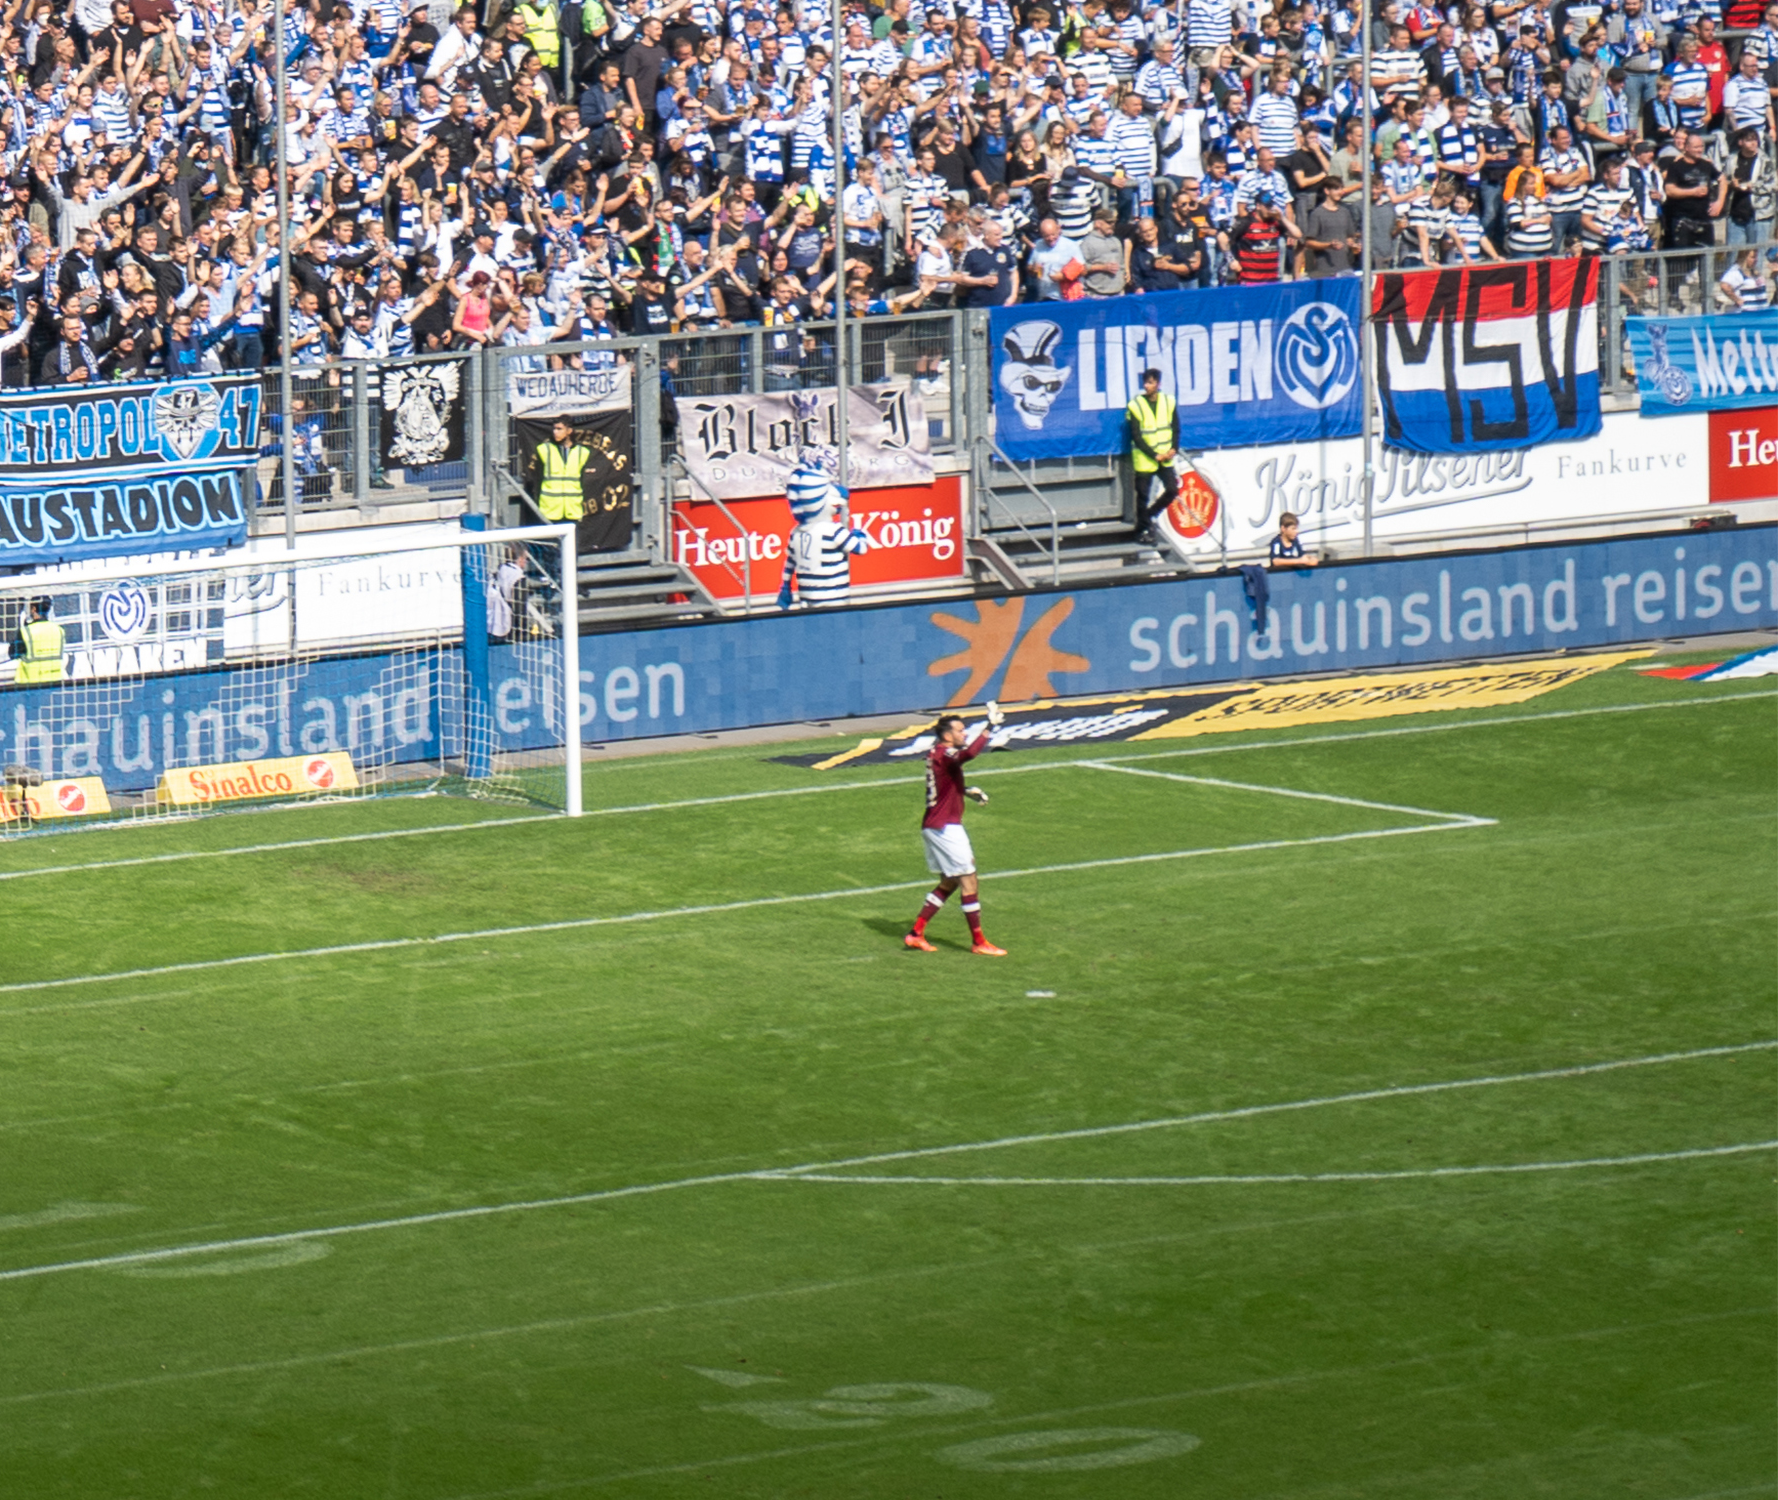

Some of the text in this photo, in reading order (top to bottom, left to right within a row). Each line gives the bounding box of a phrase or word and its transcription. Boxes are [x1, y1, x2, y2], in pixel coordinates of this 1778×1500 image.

[1076, 316, 1276, 413] LIENDEN
[1372, 255, 1596, 445] MSV
[694, 400, 853, 461] Block
[1247, 452, 1376, 528] König
[1556, 448, 1689, 481] Fankurve
[675, 507, 956, 568] Heute König
[317, 565, 462, 598] Fankurve
[66, 637, 209, 680] ANAKEN
[496, 655, 687, 748] eisen
[189, 760, 293, 802] Sinalco
